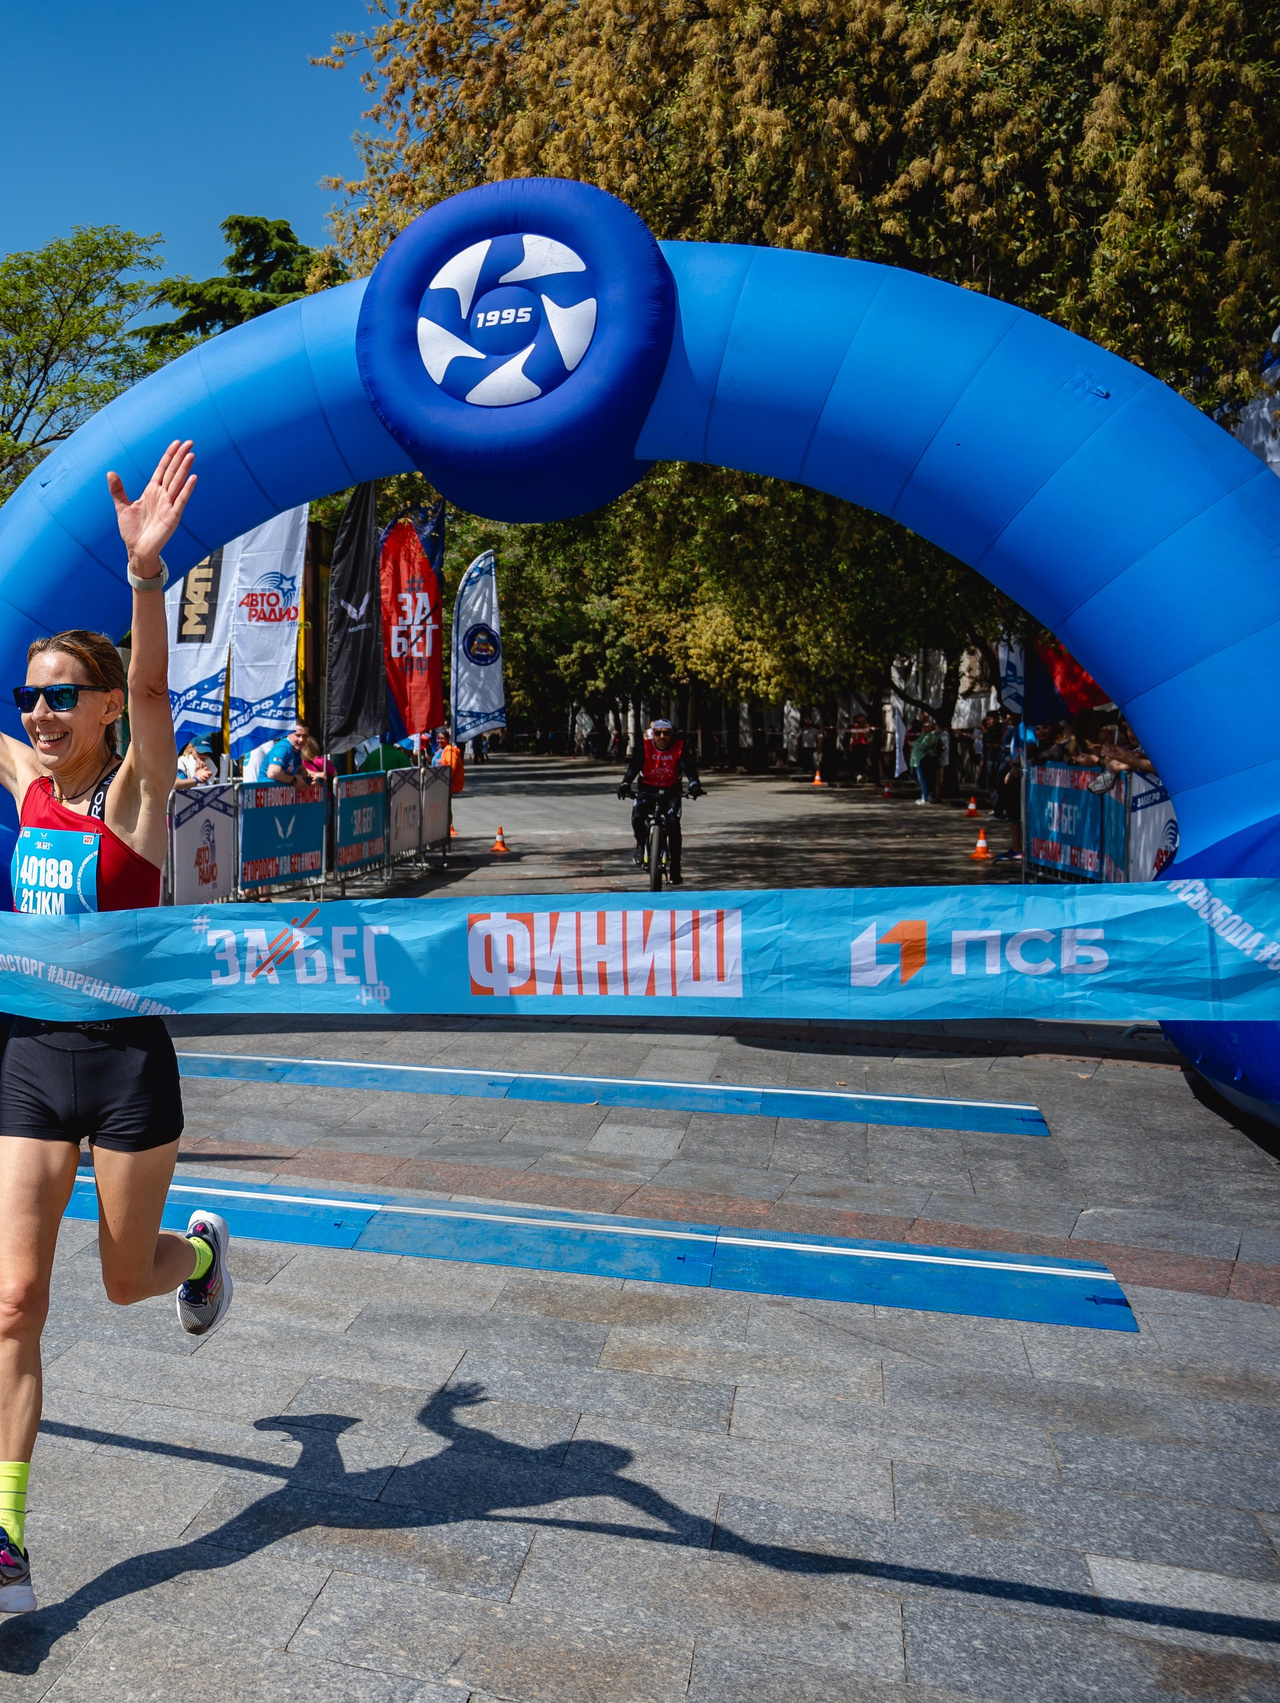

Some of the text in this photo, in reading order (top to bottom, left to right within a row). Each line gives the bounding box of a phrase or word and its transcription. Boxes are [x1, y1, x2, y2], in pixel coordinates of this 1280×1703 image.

[476, 306, 533, 329] 1995
[238, 592, 280, 608] АВТО
[247, 605, 299, 623] РАДИО
[397, 592, 433, 626] ЗА
[391, 624, 438, 658] БЕГ
[20, 854, 73, 890] 40188
[1166, 879, 1265, 956] #СВОБОДА
[468, 909, 743, 997] ФИНИШ
[951, 928, 1110, 975] ПСБ
[47, 965, 140, 1012] #АДРЕНАЛИН
